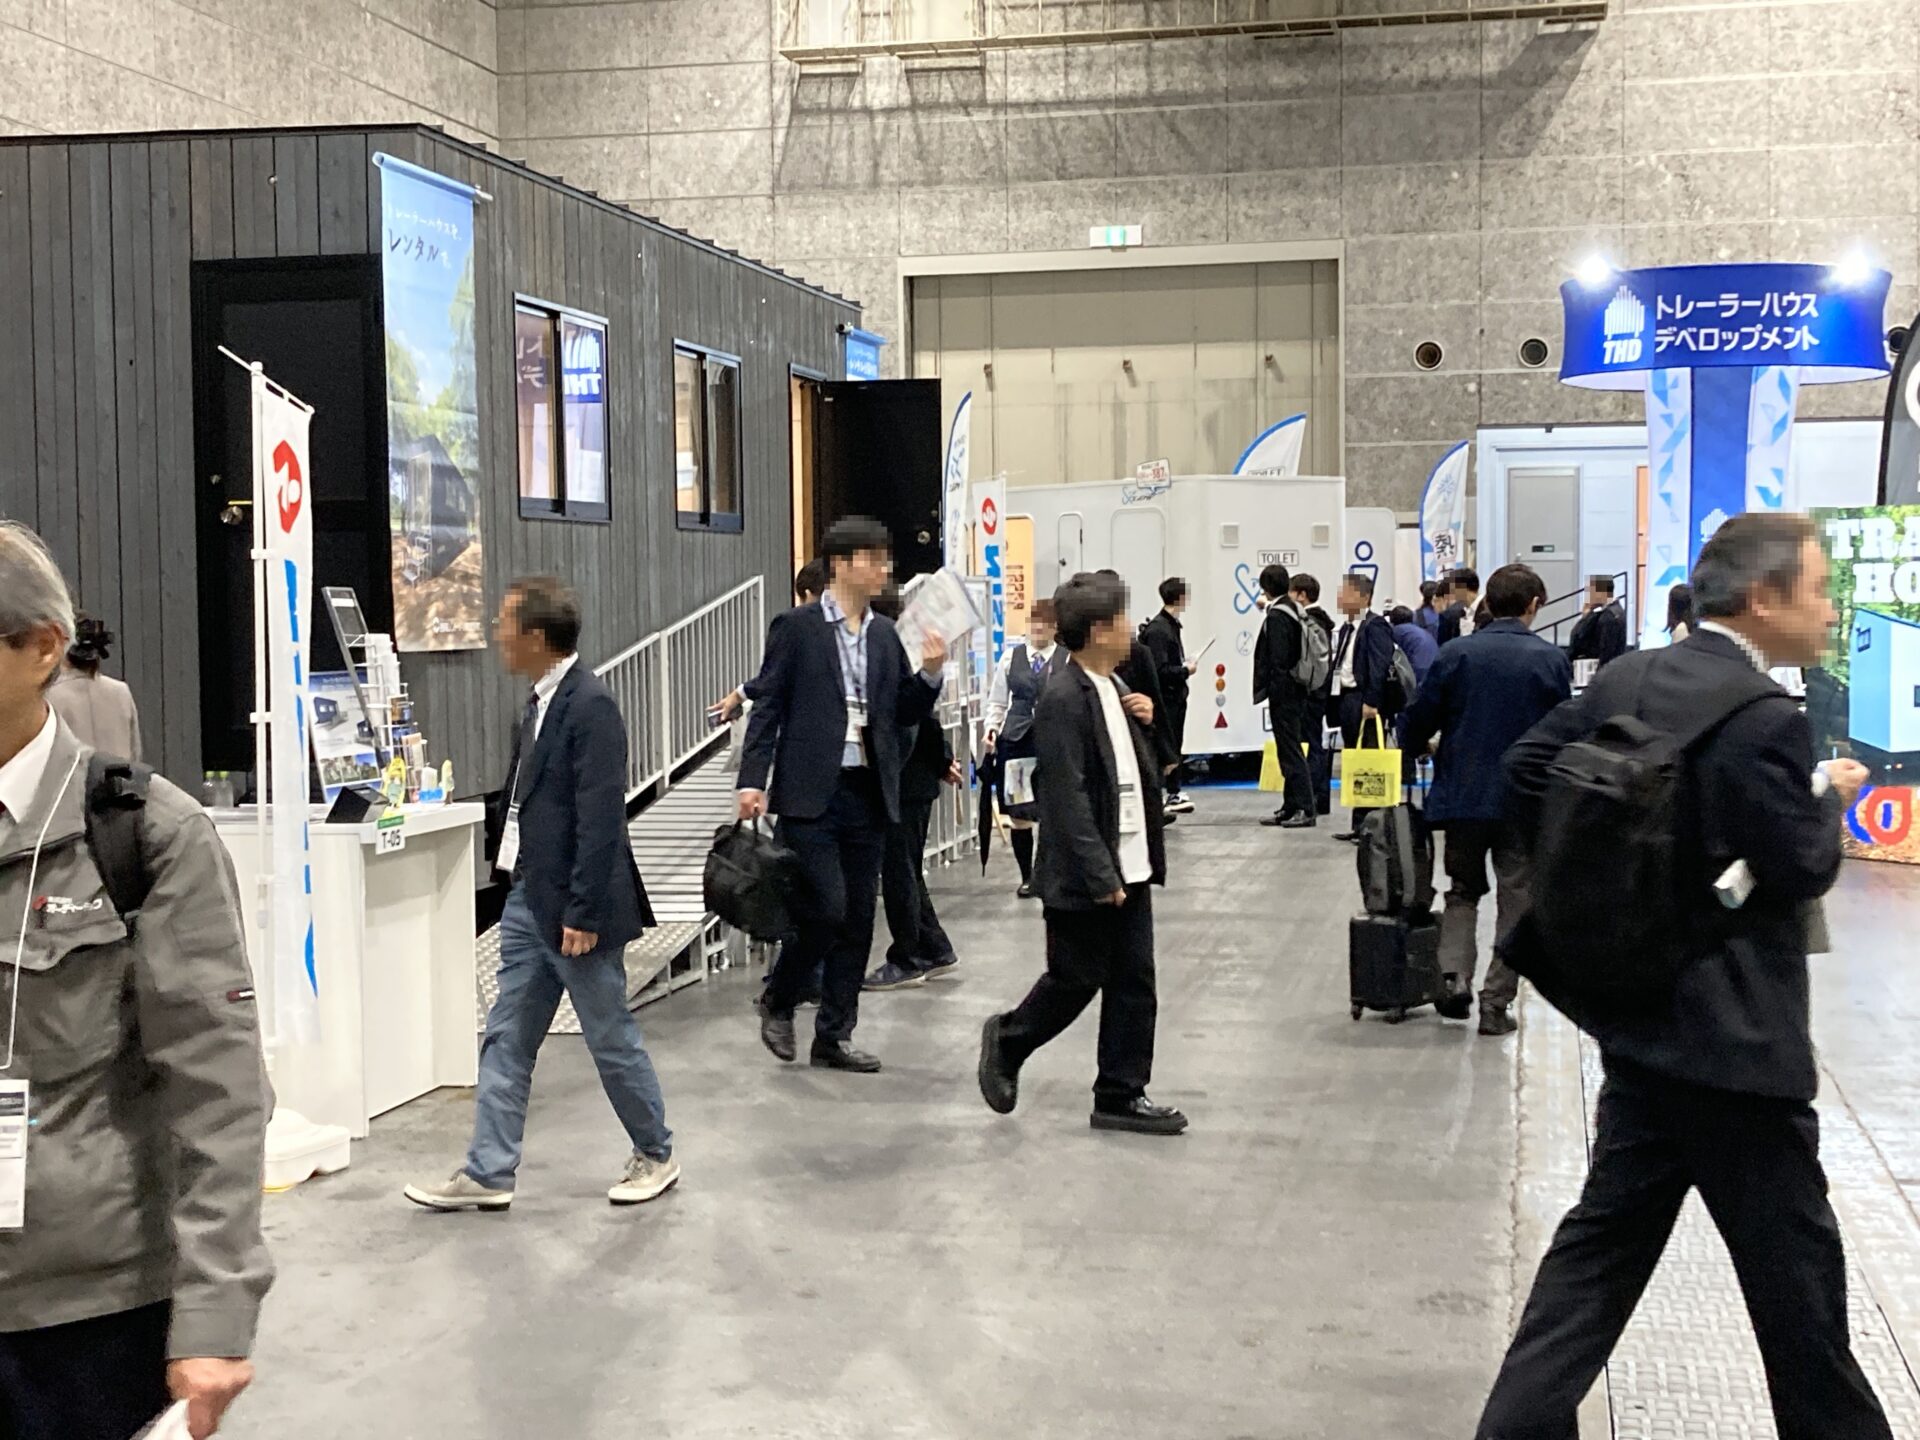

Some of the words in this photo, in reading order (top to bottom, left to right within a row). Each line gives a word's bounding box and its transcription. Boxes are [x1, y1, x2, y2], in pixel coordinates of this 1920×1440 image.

[1656, 292, 1819, 320] トレーラーハウス
[1603, 338, 1643, 364] THD
[1655, 323, 1820, 352] デベロップメント
[1261, 552, 1296, 564] TOILET
